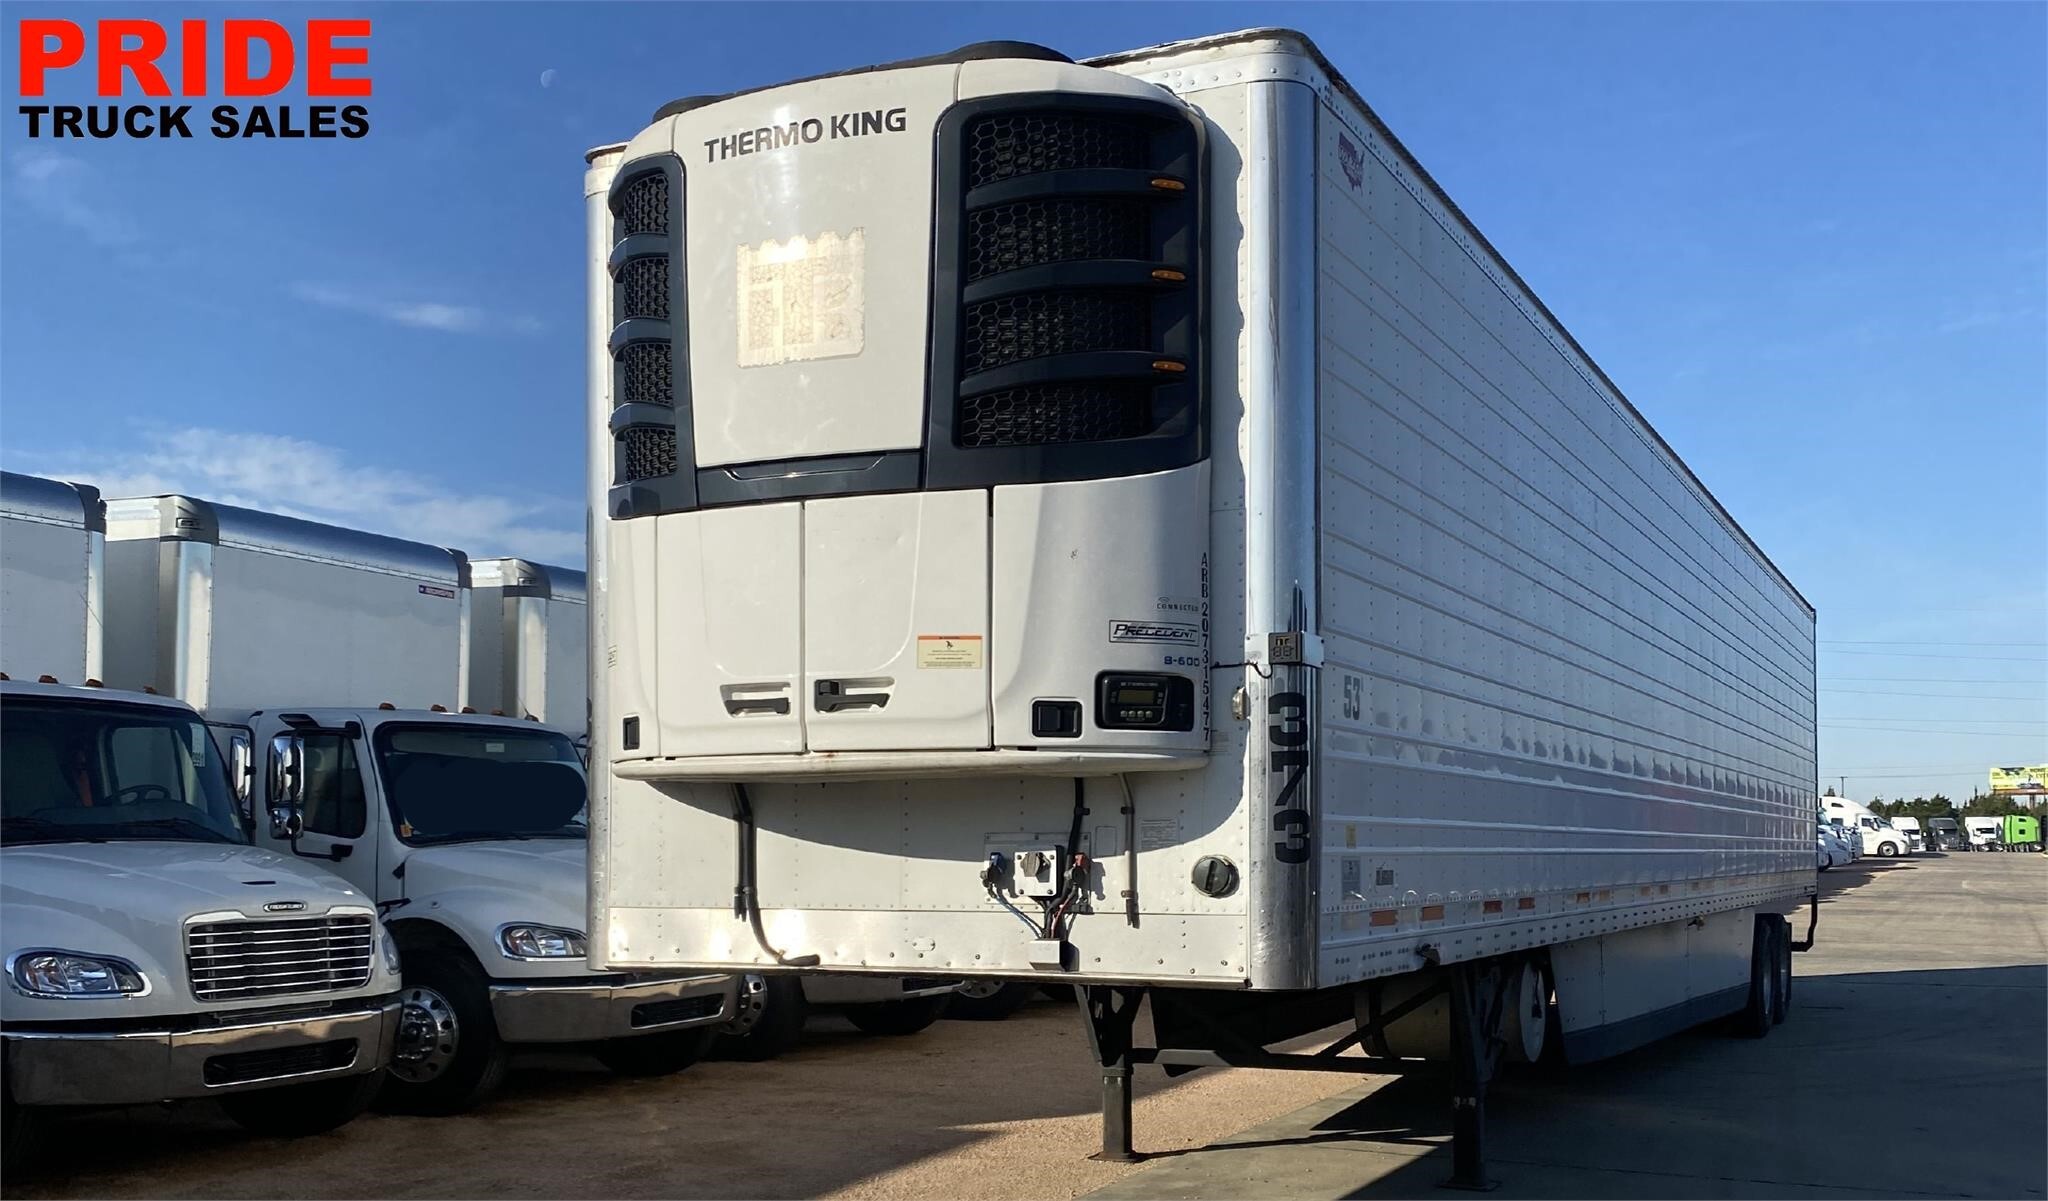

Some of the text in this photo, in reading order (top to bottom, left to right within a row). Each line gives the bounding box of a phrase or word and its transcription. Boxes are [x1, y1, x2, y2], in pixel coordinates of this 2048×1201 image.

[704, 107, 906, 163] THERMO KING
[1113, 624, 1197, 640] PRECEDENT
[1268, 692, 1311, 864] 373
